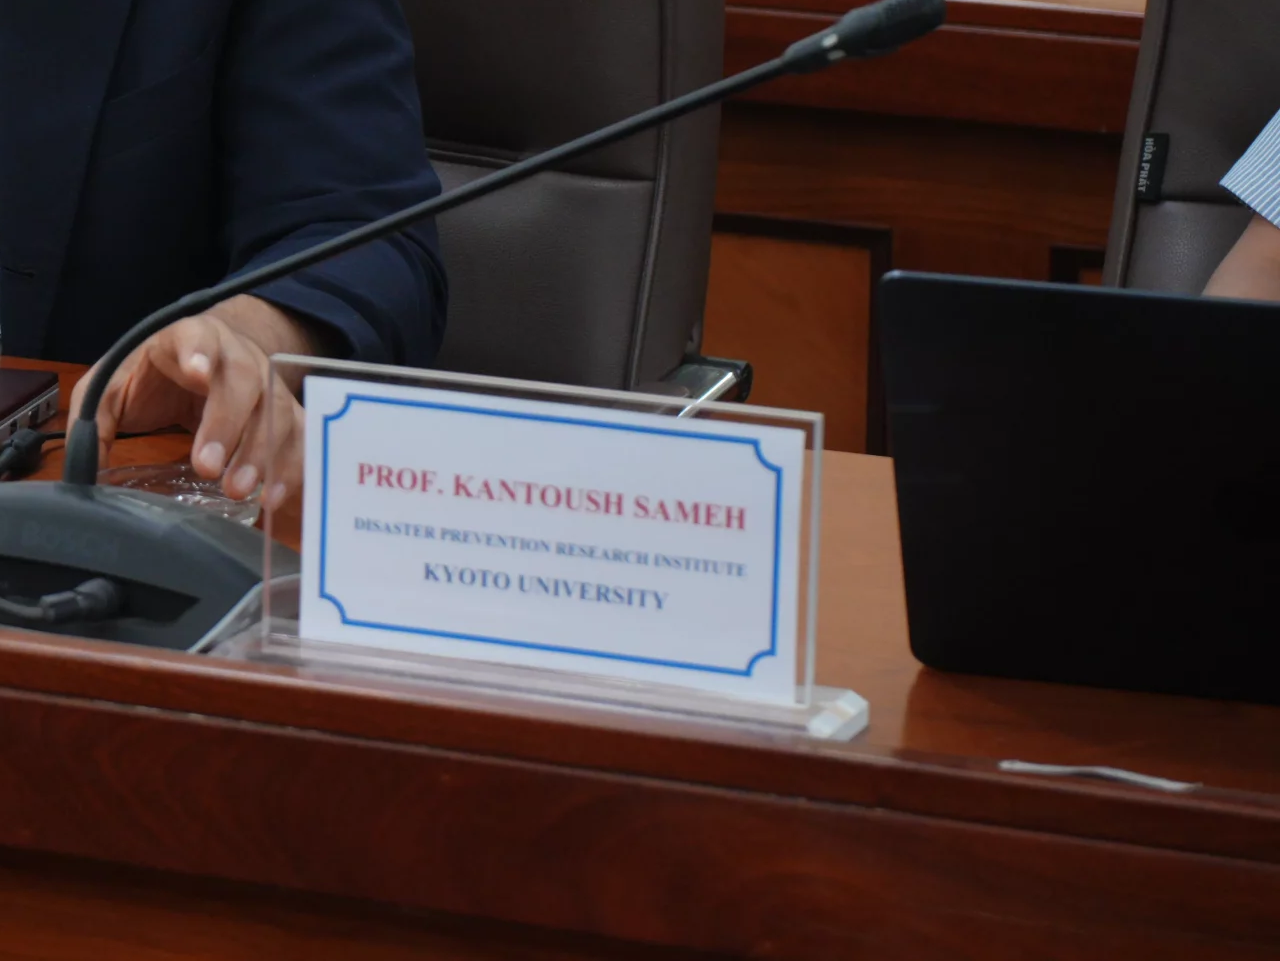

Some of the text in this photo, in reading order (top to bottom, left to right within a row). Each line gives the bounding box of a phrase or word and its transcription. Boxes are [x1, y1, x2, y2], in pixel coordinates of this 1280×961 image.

[1138, 137, 1156, 193] HÒA PHÁT
[356, 461, 746, 531] PROF. KANTOUSH SAMEH
[353, 516, 748, 578] DISASTER PREVENTION RESEARCH INSTITUTE
[423, 561, 670, 611] KYOTO UNIVERSITY
